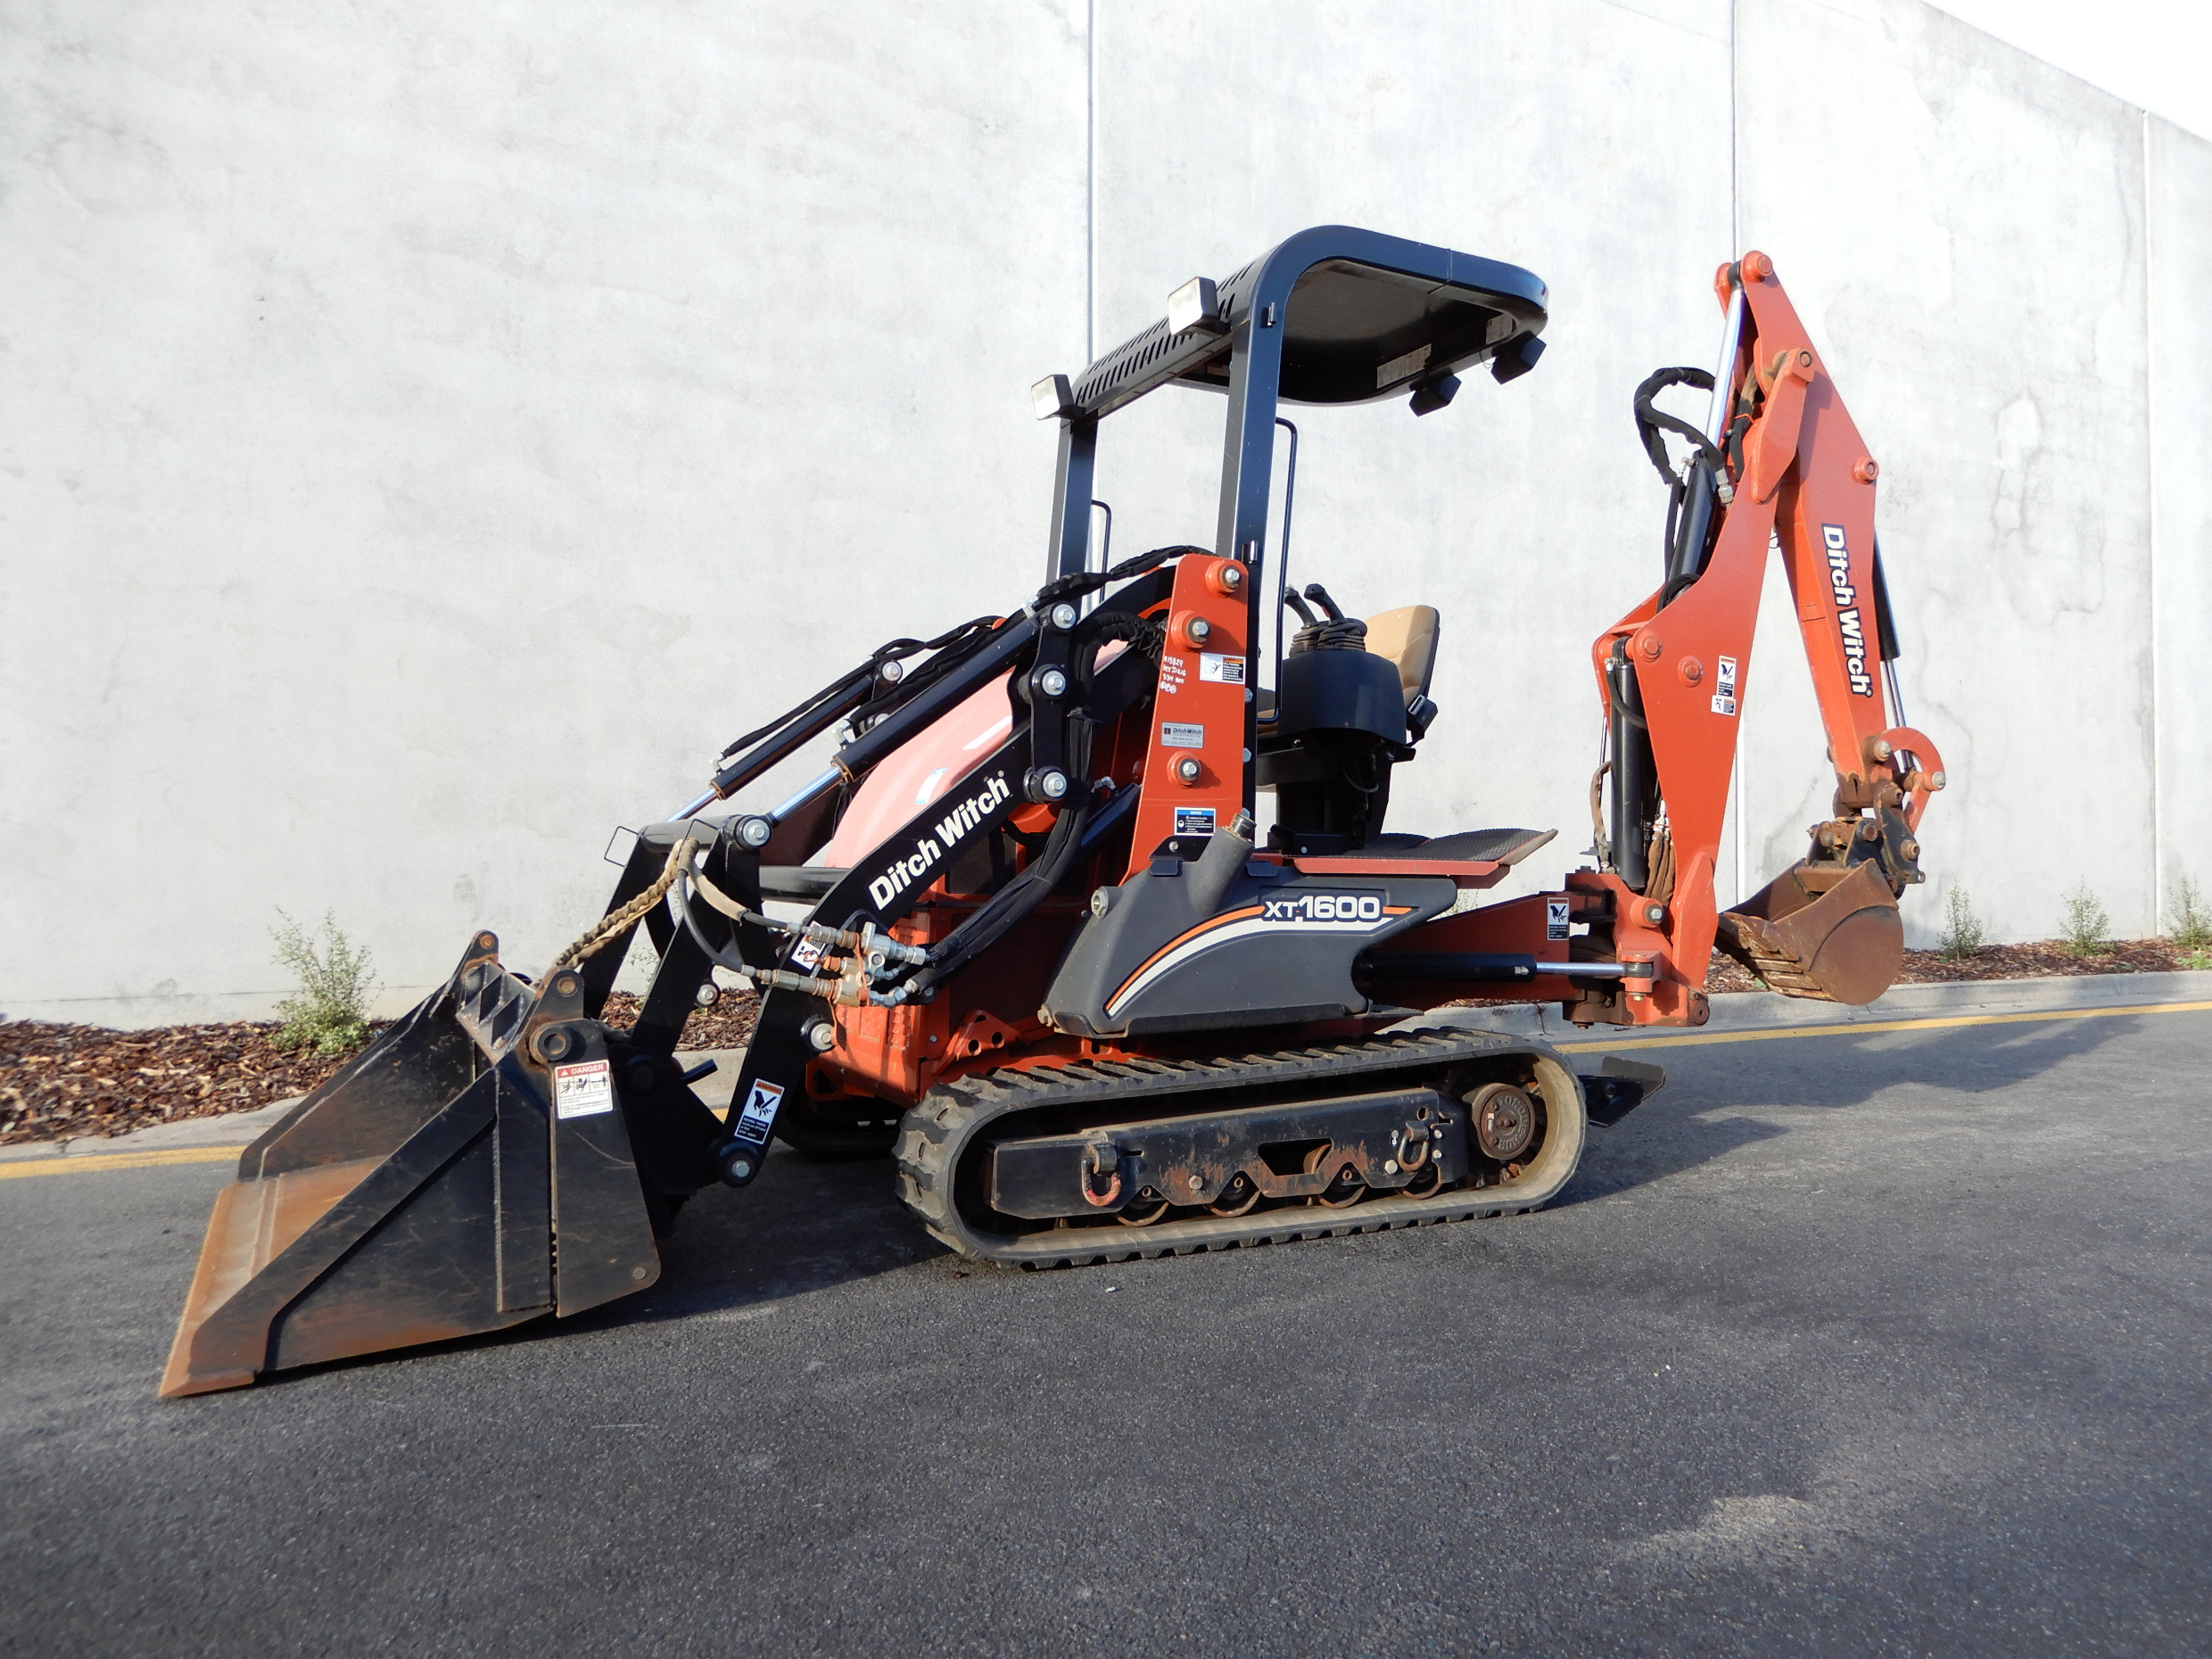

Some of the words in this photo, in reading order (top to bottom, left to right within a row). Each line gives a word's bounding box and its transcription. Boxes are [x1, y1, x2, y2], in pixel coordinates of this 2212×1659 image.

[1822, 524, 1855, 606] Ditch
[1837, 608, 1871, 694] Witch
[868, 838, 942, 911] Ditch
[935, 777, 1011, 847] Witch
[571, 1064, 605, 1075] DANGER
